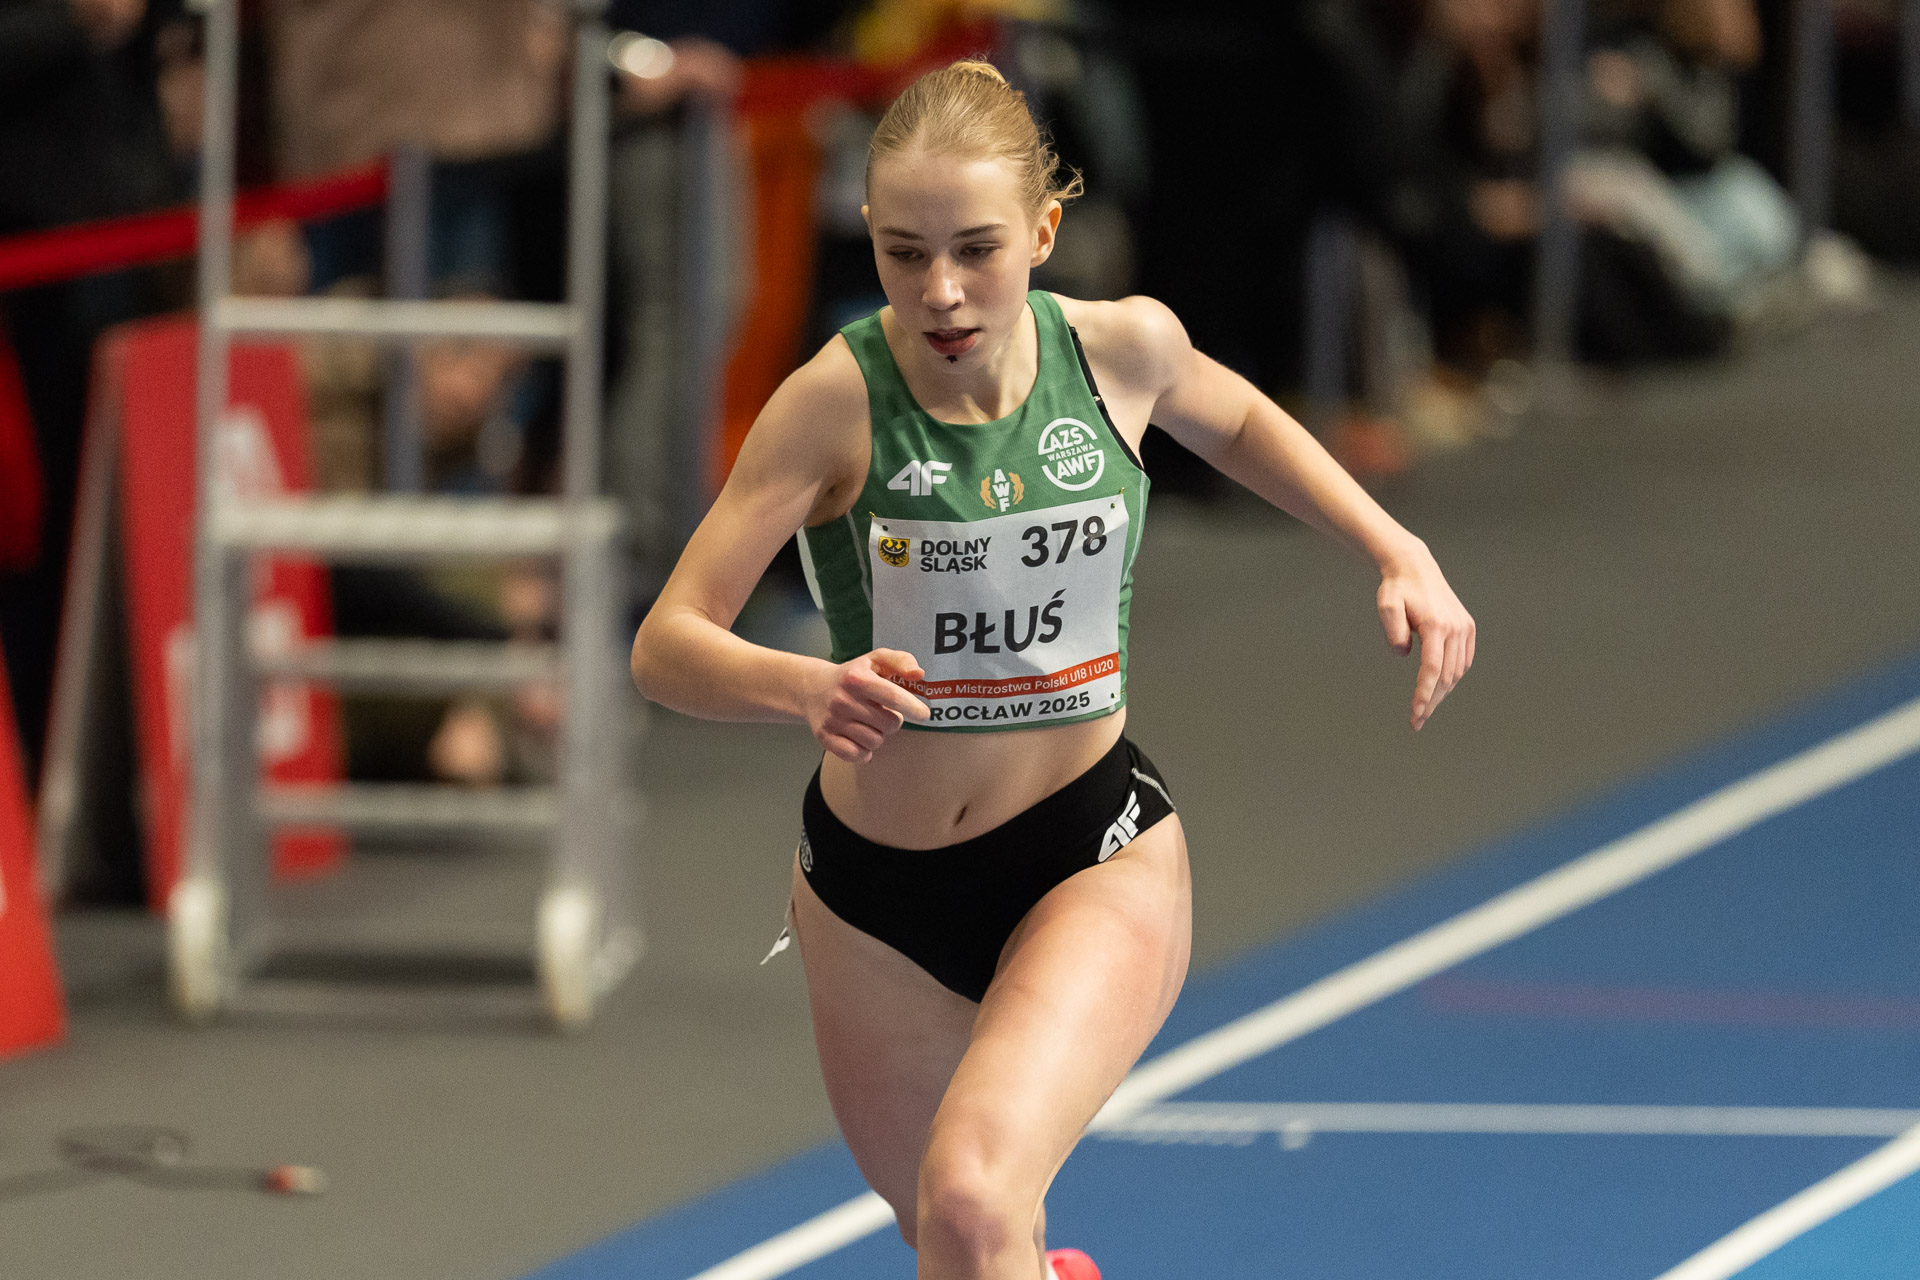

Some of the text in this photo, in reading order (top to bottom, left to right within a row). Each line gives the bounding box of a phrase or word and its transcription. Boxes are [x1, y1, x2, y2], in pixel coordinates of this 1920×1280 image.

[1047, 443, 1095, 461] WARSZAWA
[1050, 427, 1084, 449] AZS
[887, 459, 952, 496] 4F
[1057, 454, 1096, 480] AWF
[920, 536, 991, 556] DOLNY
[1021, 516, 1107, 567] 378
[920, 554, 987, 574] ŚLĄSK
[934, 588, 1066, 655] BŁUŚ
[955, 682, 1031, 695] Mistrzostwa
[1035, 673, 1068, 690] Polski
[1070, 668, 1087, 683] U18
[1094, 659, 1114, 674] U20
[929, 691, 1090, 720] ROCŁAW 2025
[1097, 790, 1141, 863] 4F
